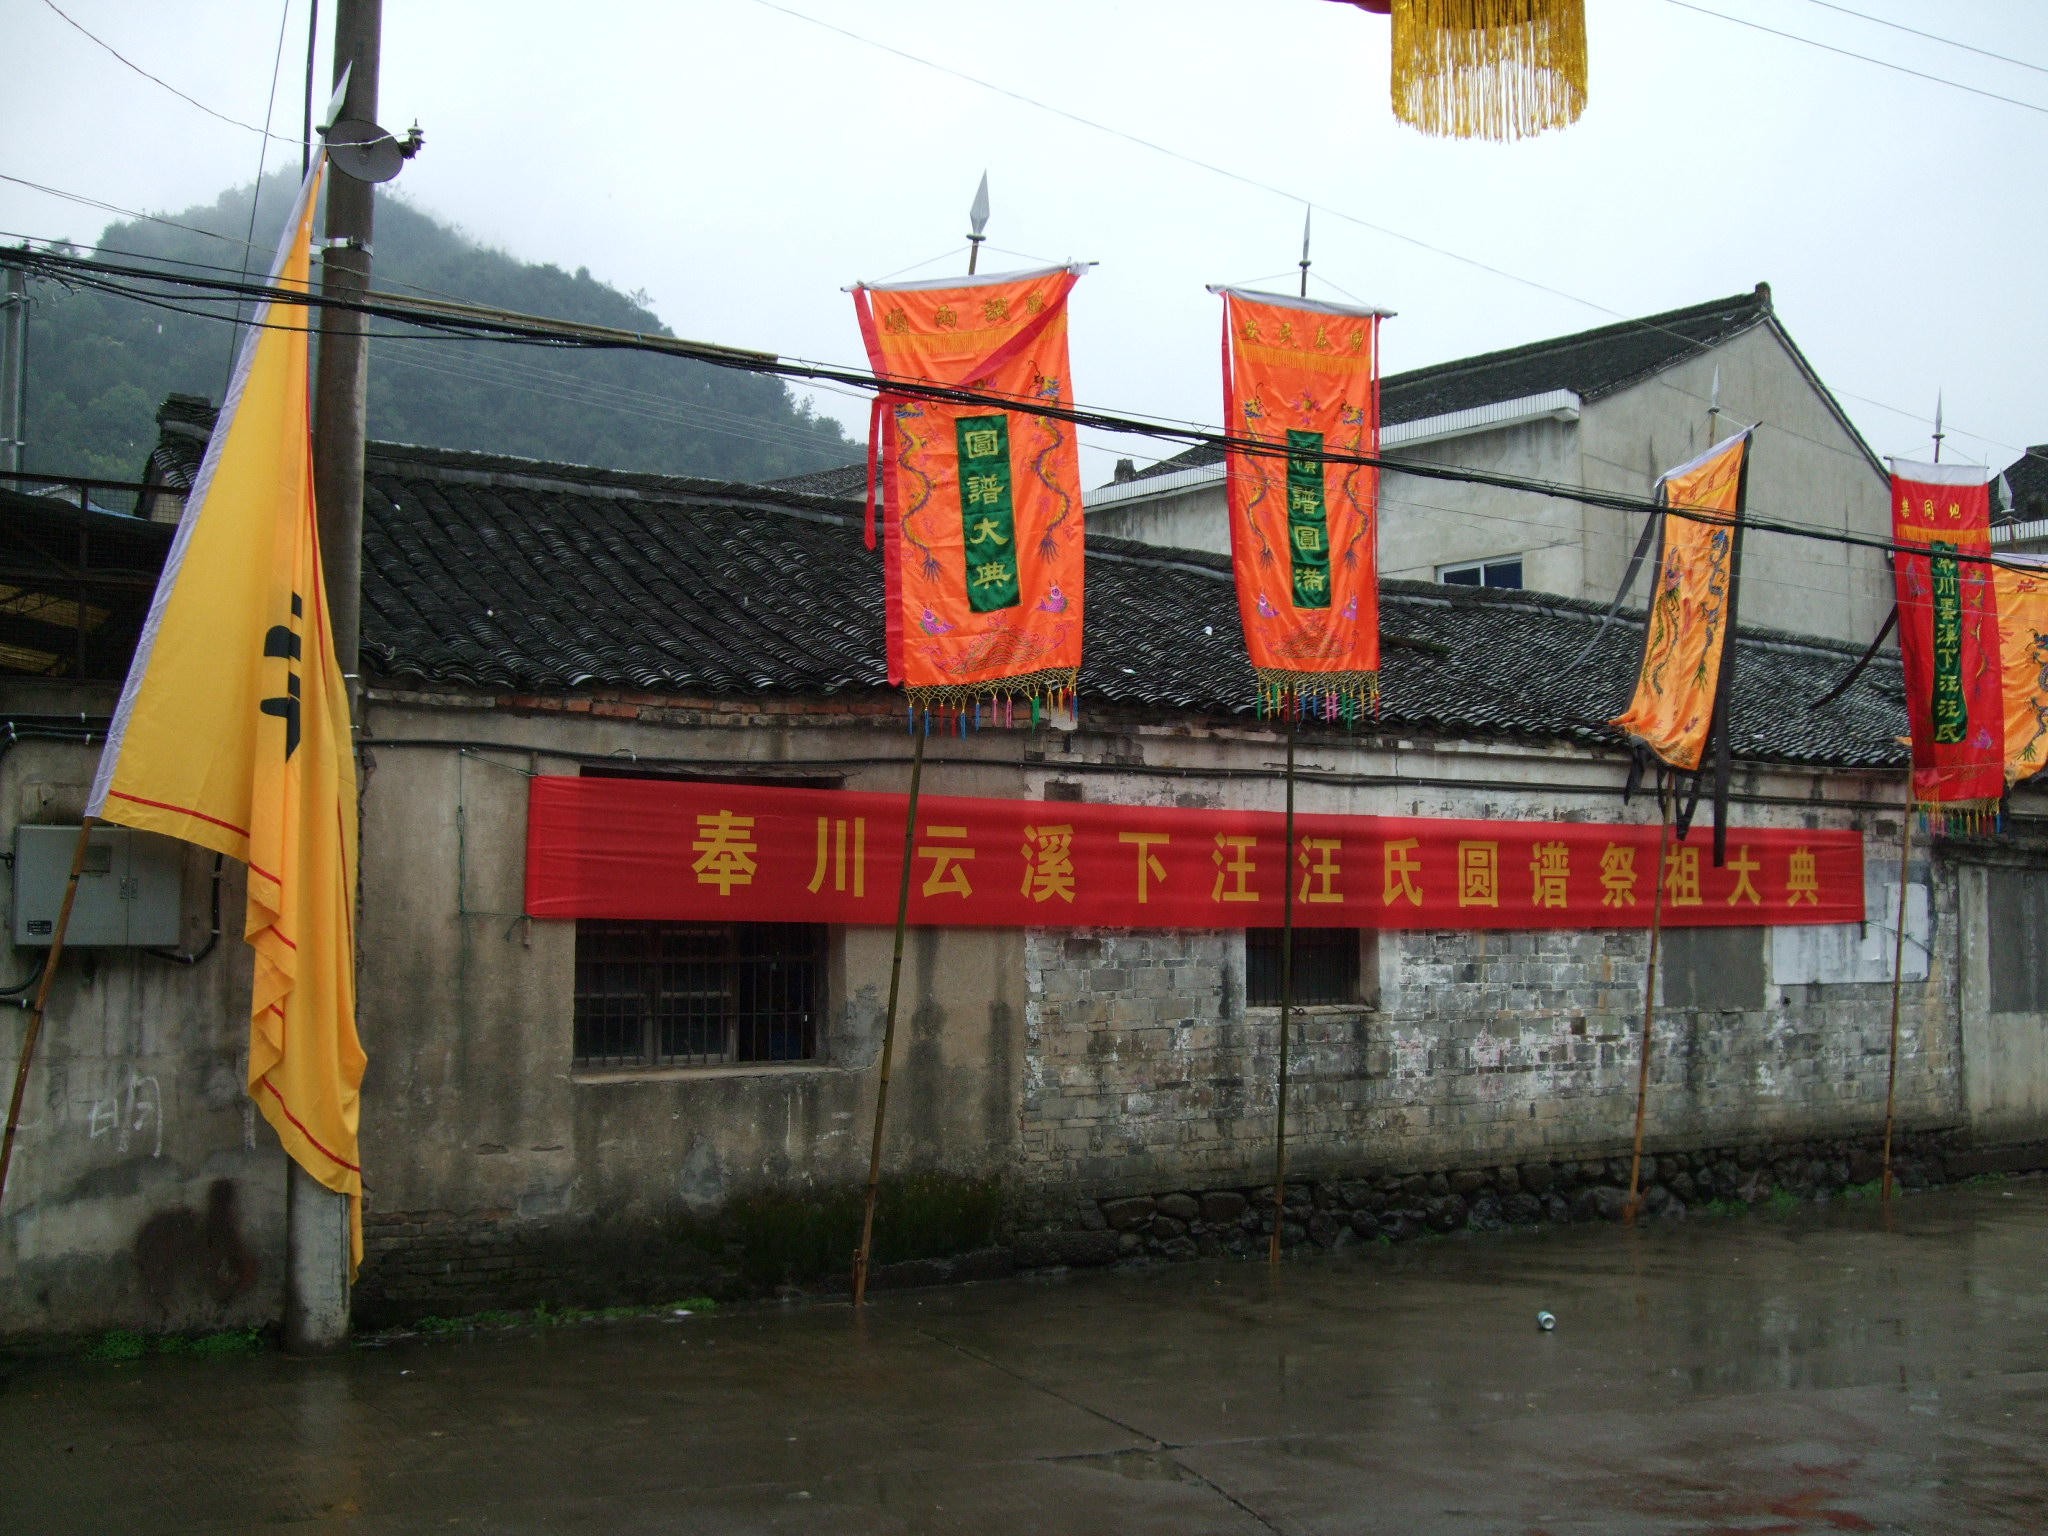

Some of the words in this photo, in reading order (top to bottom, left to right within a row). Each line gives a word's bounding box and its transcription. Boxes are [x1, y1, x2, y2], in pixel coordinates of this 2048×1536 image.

[965, 430, 1012, 590] 圓譜大典
[691, 808, 1819, 909] 奉川云溪下汪汪氏圆谱祭祖大典
